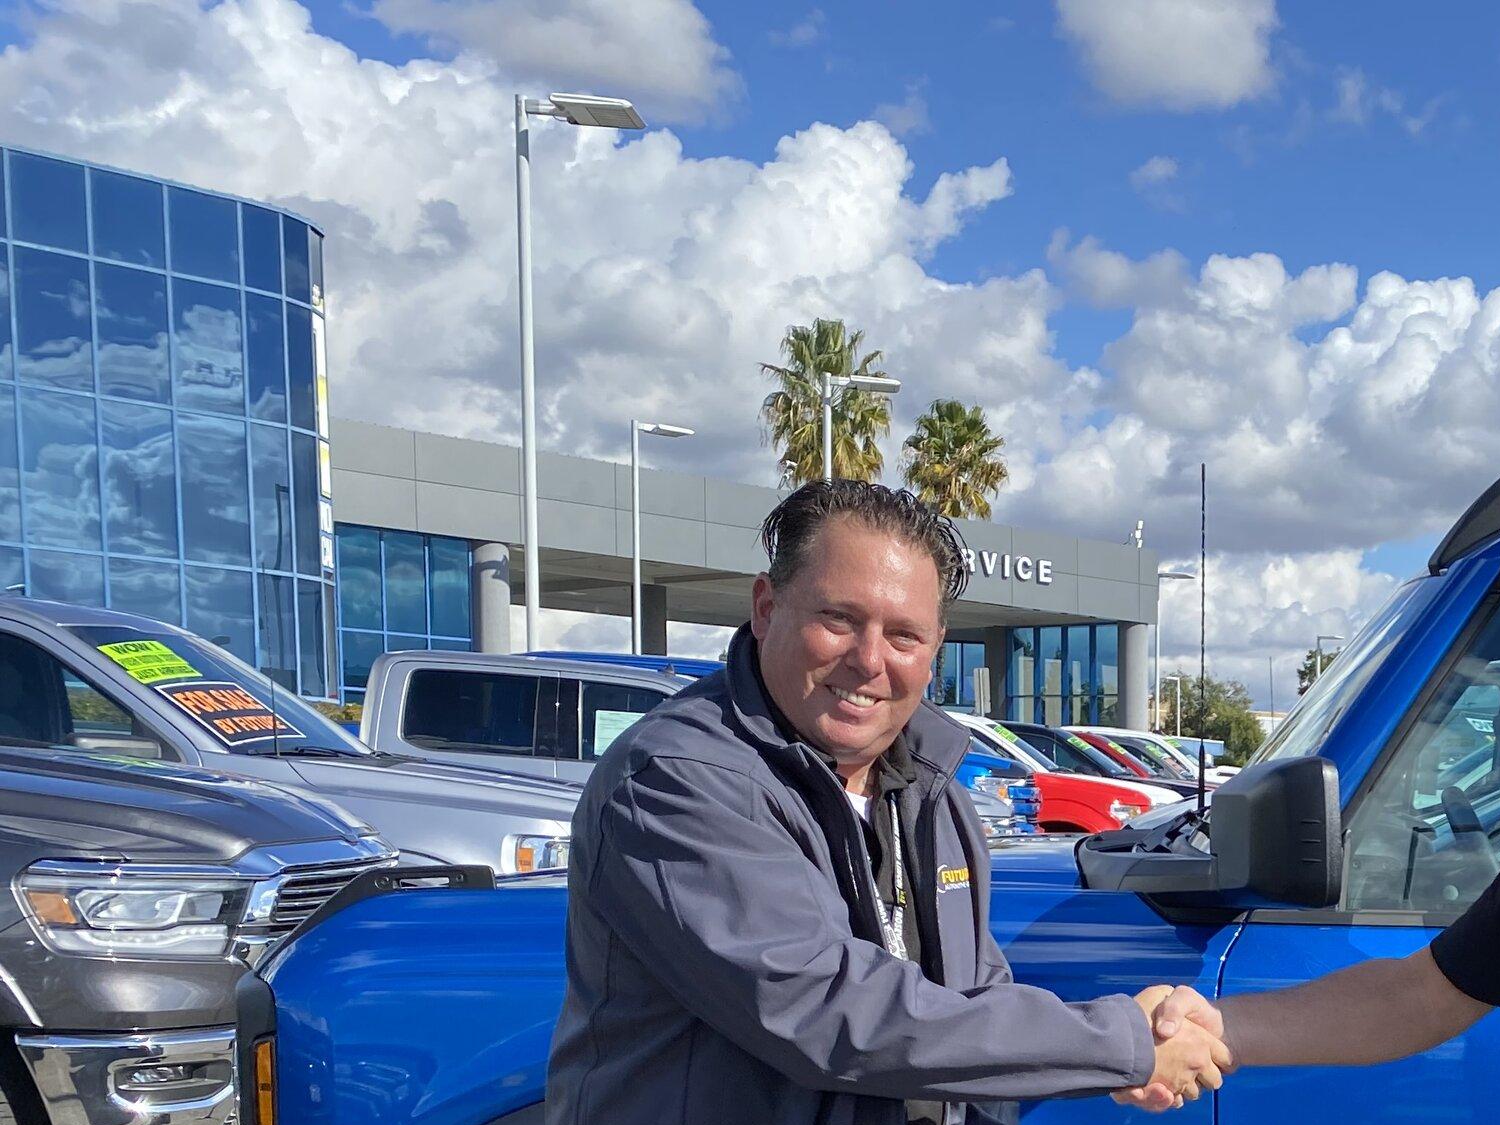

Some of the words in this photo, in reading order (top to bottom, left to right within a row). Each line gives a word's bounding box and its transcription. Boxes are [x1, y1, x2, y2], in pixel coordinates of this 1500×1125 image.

[173, 690, 228, 714] FOR
[209, 689, 265, 710] SALE
[213, 717, 242, 734] BY
